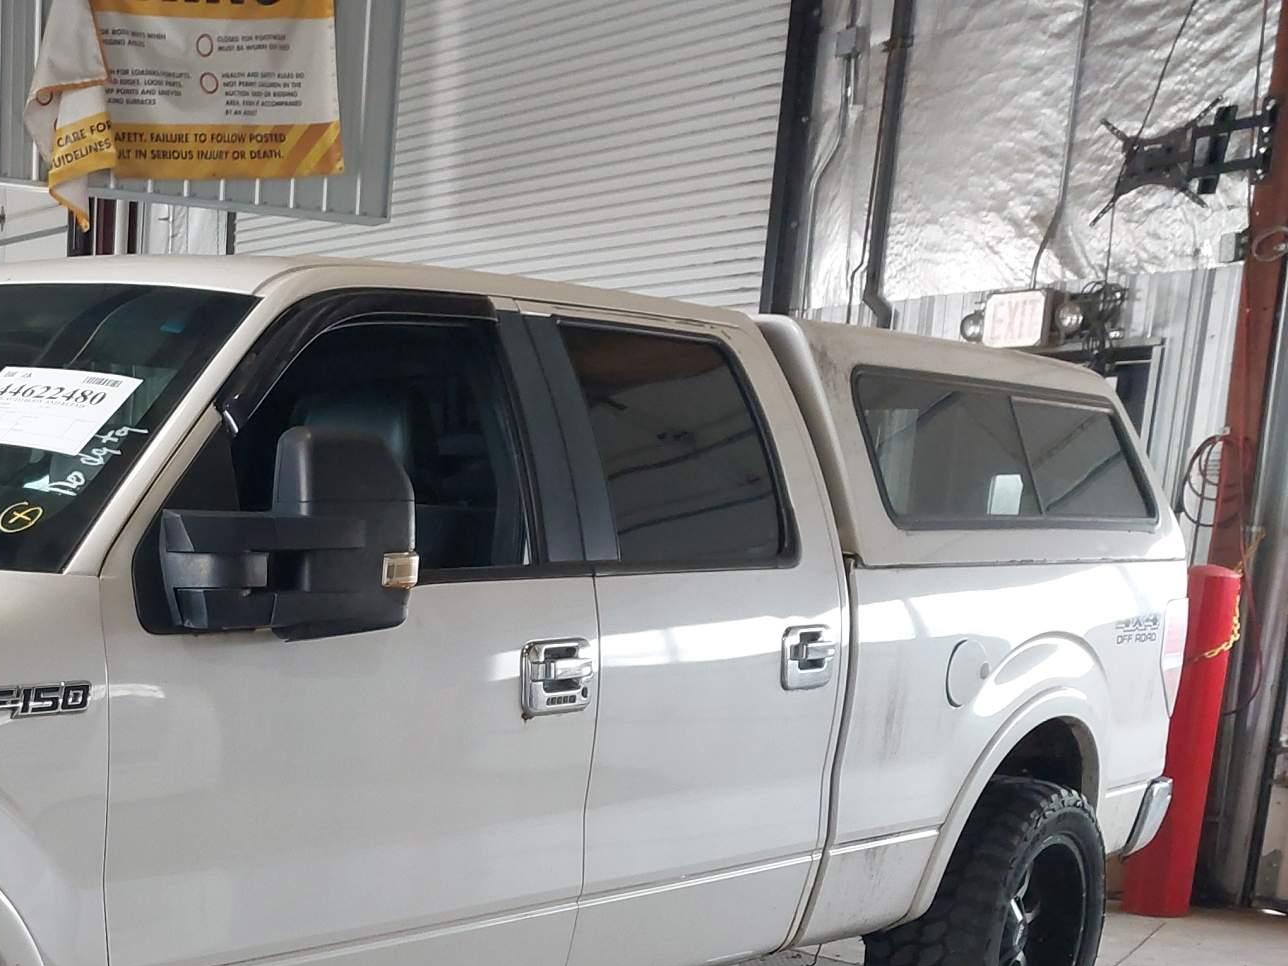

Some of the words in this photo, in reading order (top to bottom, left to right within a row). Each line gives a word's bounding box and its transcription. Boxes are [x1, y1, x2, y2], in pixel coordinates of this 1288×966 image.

[57, 128, 89, 148] CARE
[150, 133, 189, 144] FAILURE
[194, 133, 207, 144] TO
[211, 133, 246, 144] FOLLOW
[249, 133, 287, 144] POSTED
[135, 149, 148, 160] IN
[150, 149, 194, 160] SERIOUS
[197, 149, 229, 161] INJURY
[232, 149, 247, 161] OR
[249, 149, 285, 160] DEATH.
[991, 299, 1040, 340] EXIT
[1116, 634, 1133, 644] OFF
[1135, 632, 1157, 643] ROAD
